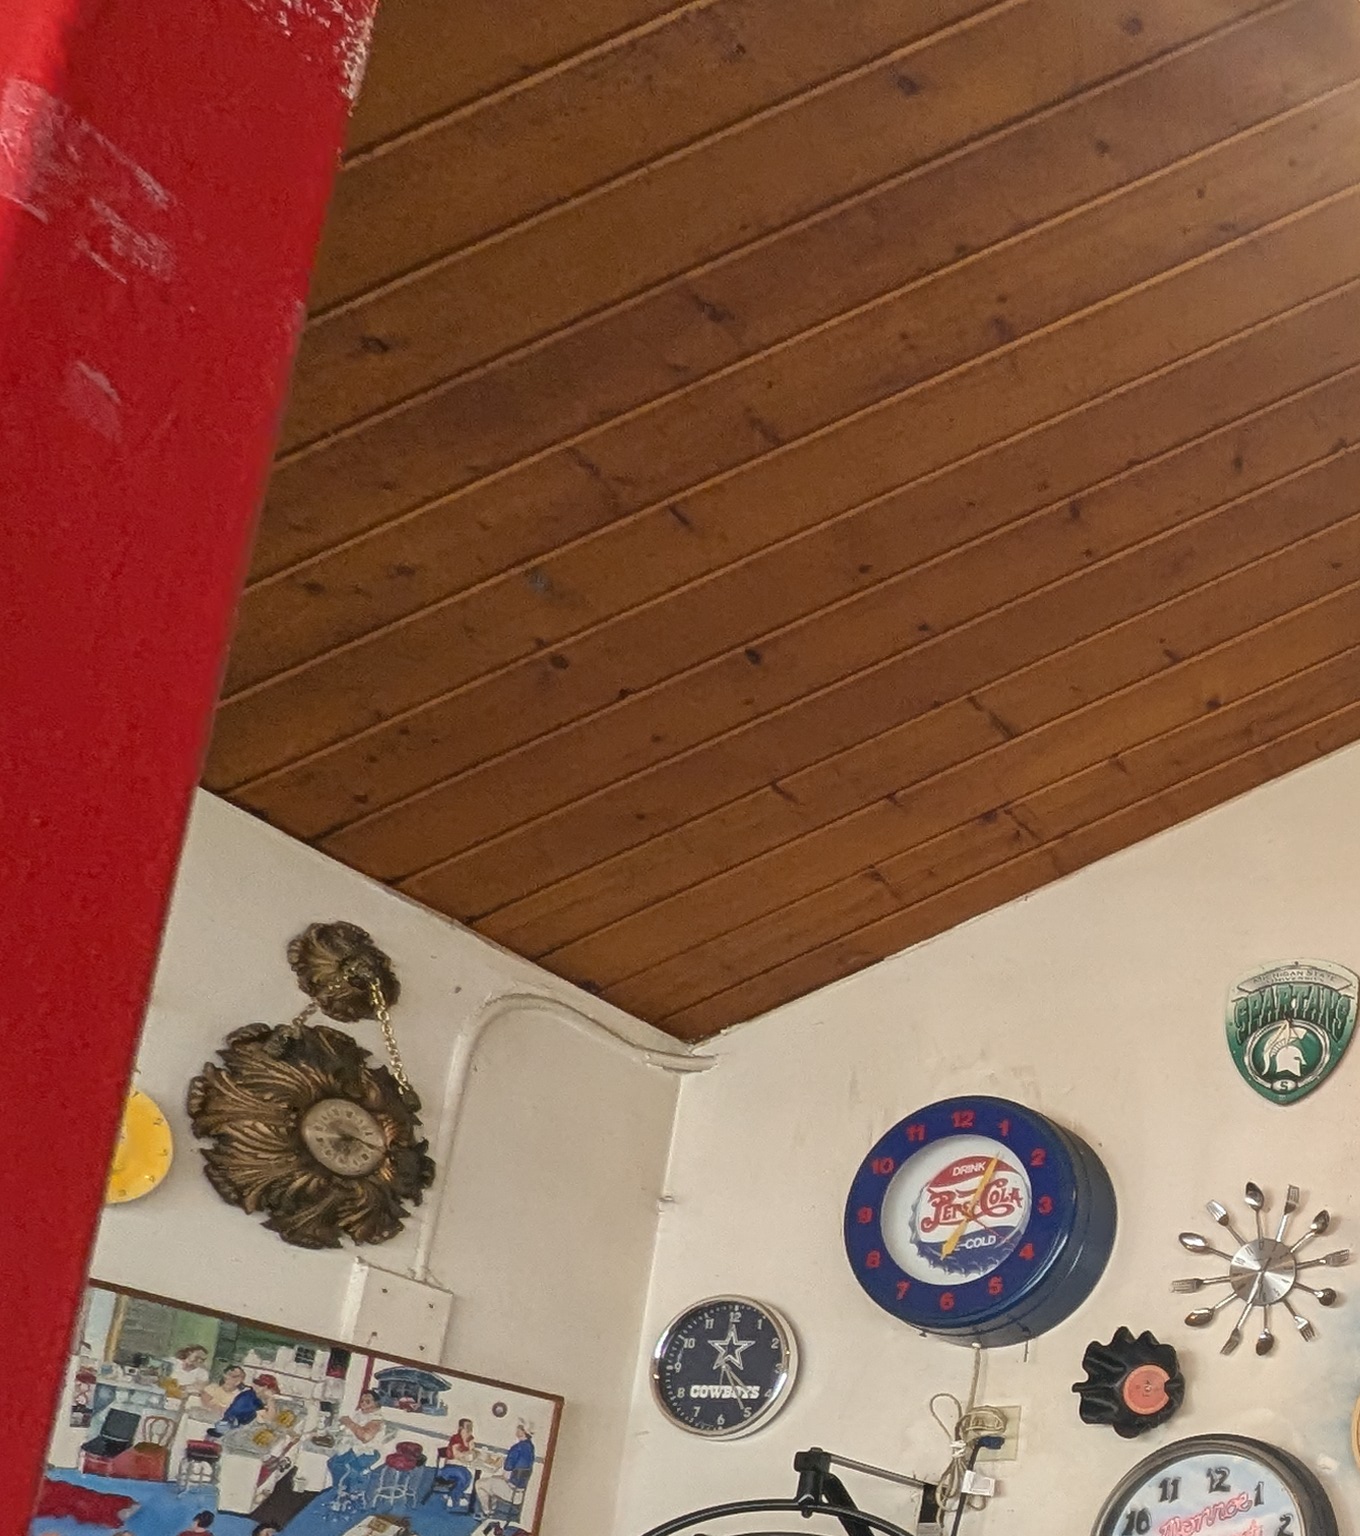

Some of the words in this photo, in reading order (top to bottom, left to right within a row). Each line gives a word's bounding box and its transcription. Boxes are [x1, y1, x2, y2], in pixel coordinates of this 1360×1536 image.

[1280, 1082, 1288, 1091] S
[952, 1110, 976, 1128] 12
[953, 1162, 986, 1176] DRINK
[690, 1385, 760, 1399] COWBOYS
[1158, 1476, 1182, 1503] 11
[1206, 1466, 1231, 1492] 12
[1254, 1481, 1265, 1505] 1
[1122, 1508, 1151, 1536] 10
